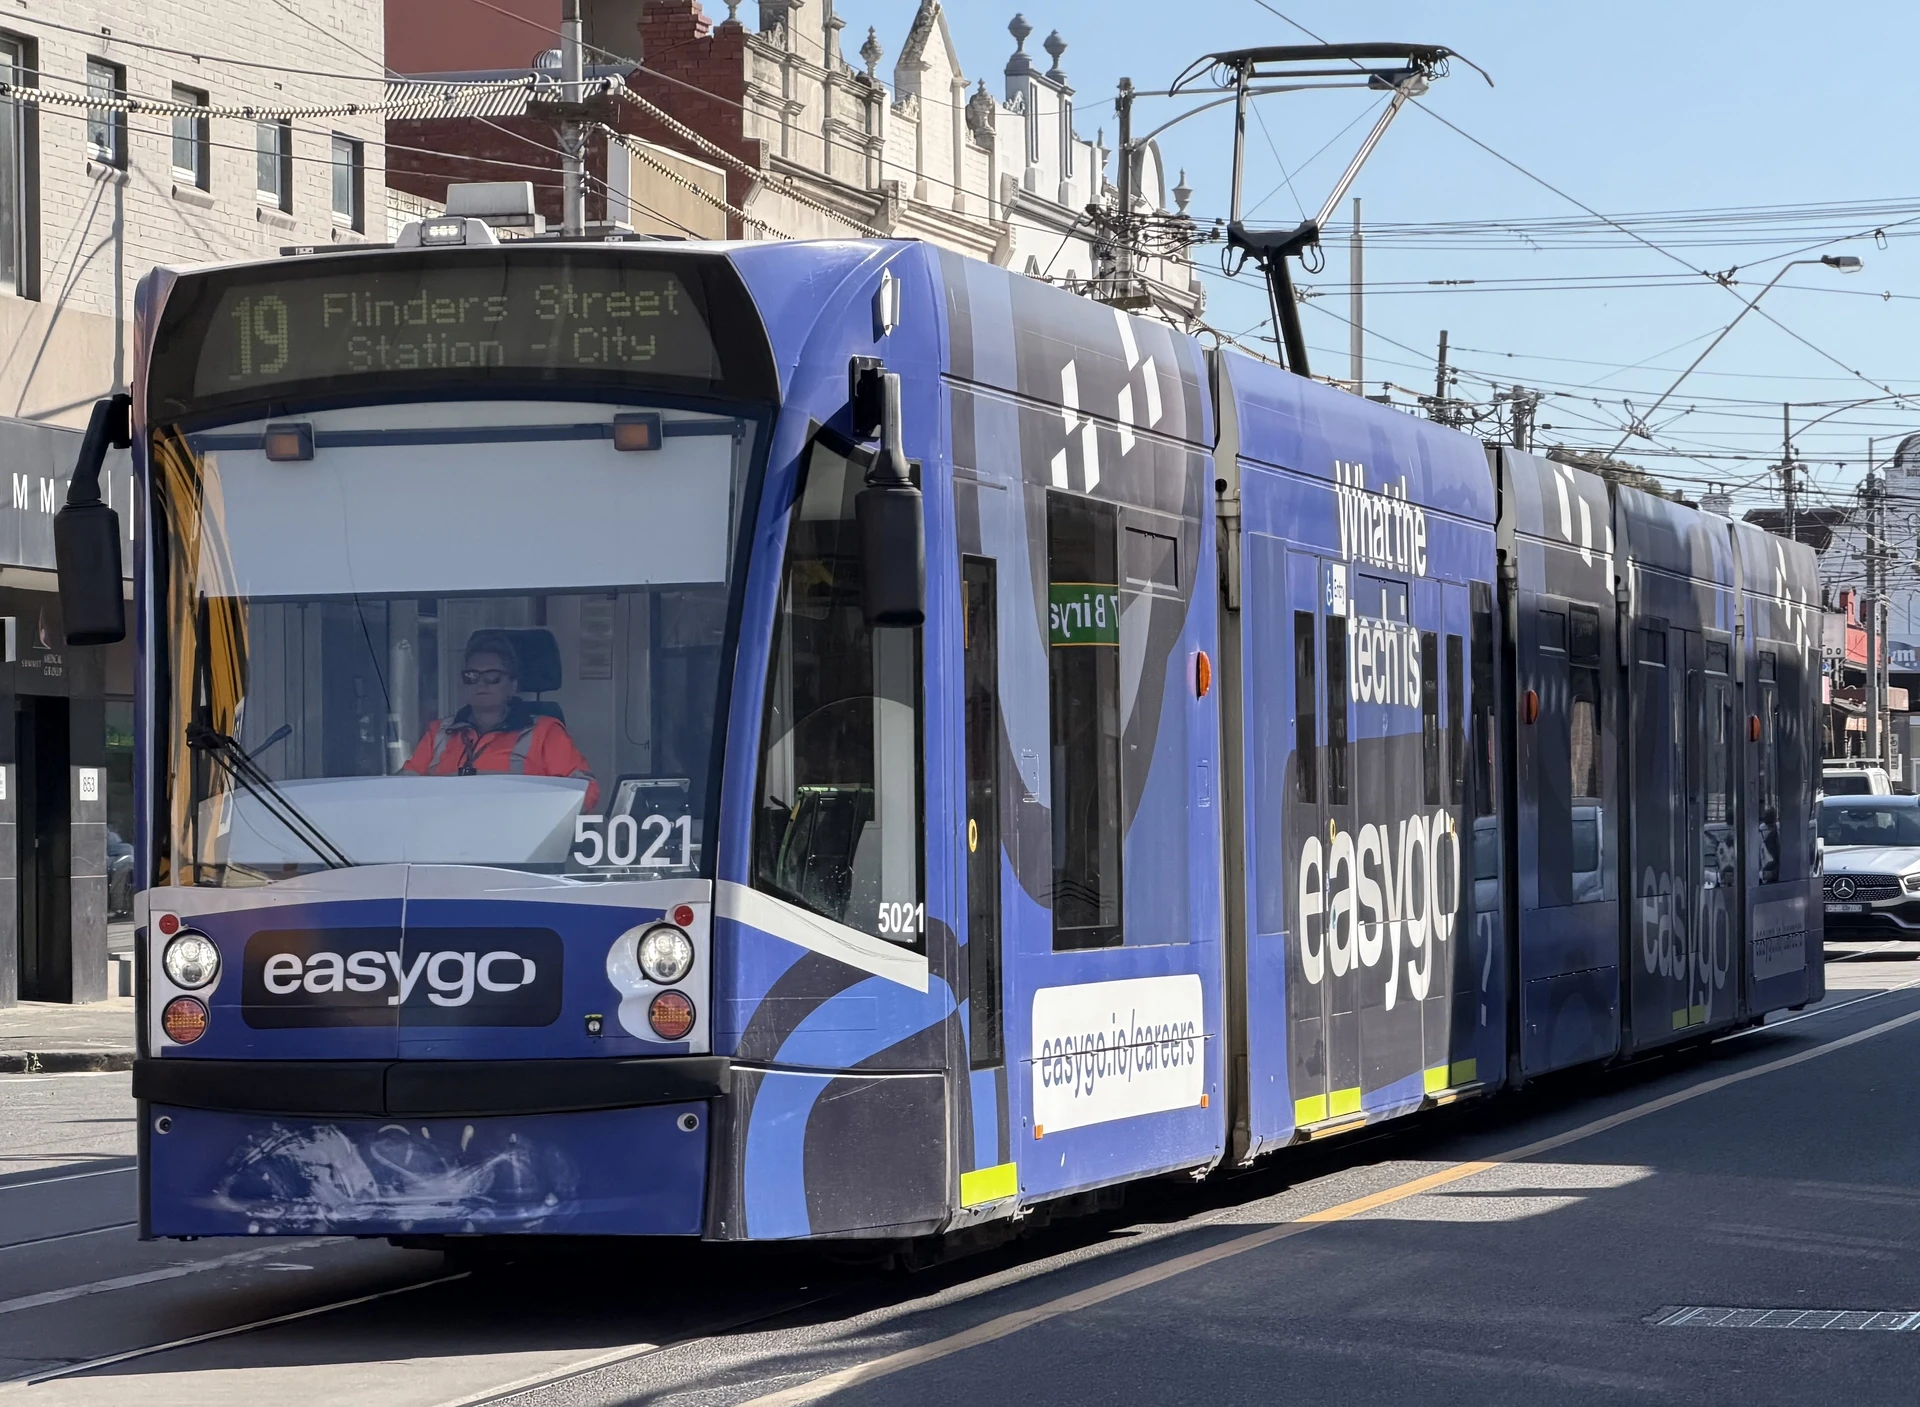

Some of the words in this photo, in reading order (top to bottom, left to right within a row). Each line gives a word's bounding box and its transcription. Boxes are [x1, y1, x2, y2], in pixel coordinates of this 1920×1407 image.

[229, 294, 290, 381] 19
[322, 289, 509, 327] Flinders
[534, 280, 681, 320] Street
[347, 333, 505, 372] Station
[572, 326, 657, 363] City
[1335, 460, 1393, 568] What
[1394, 475, 1427, 577] the
[1348, 589, 1399, 705] tech
[1400, 595, 1421, 709] is
[573, 814, 692, 866] 5021
[878, 902, 924, 933] 5021
[1299, 808, 1461, 1011] easygo
[1643, 865, 1730, 1024] easygo
[263, 950, 537, 1007] easygo
[1041, 1008, 1195, 1099] easygo.io/careers
